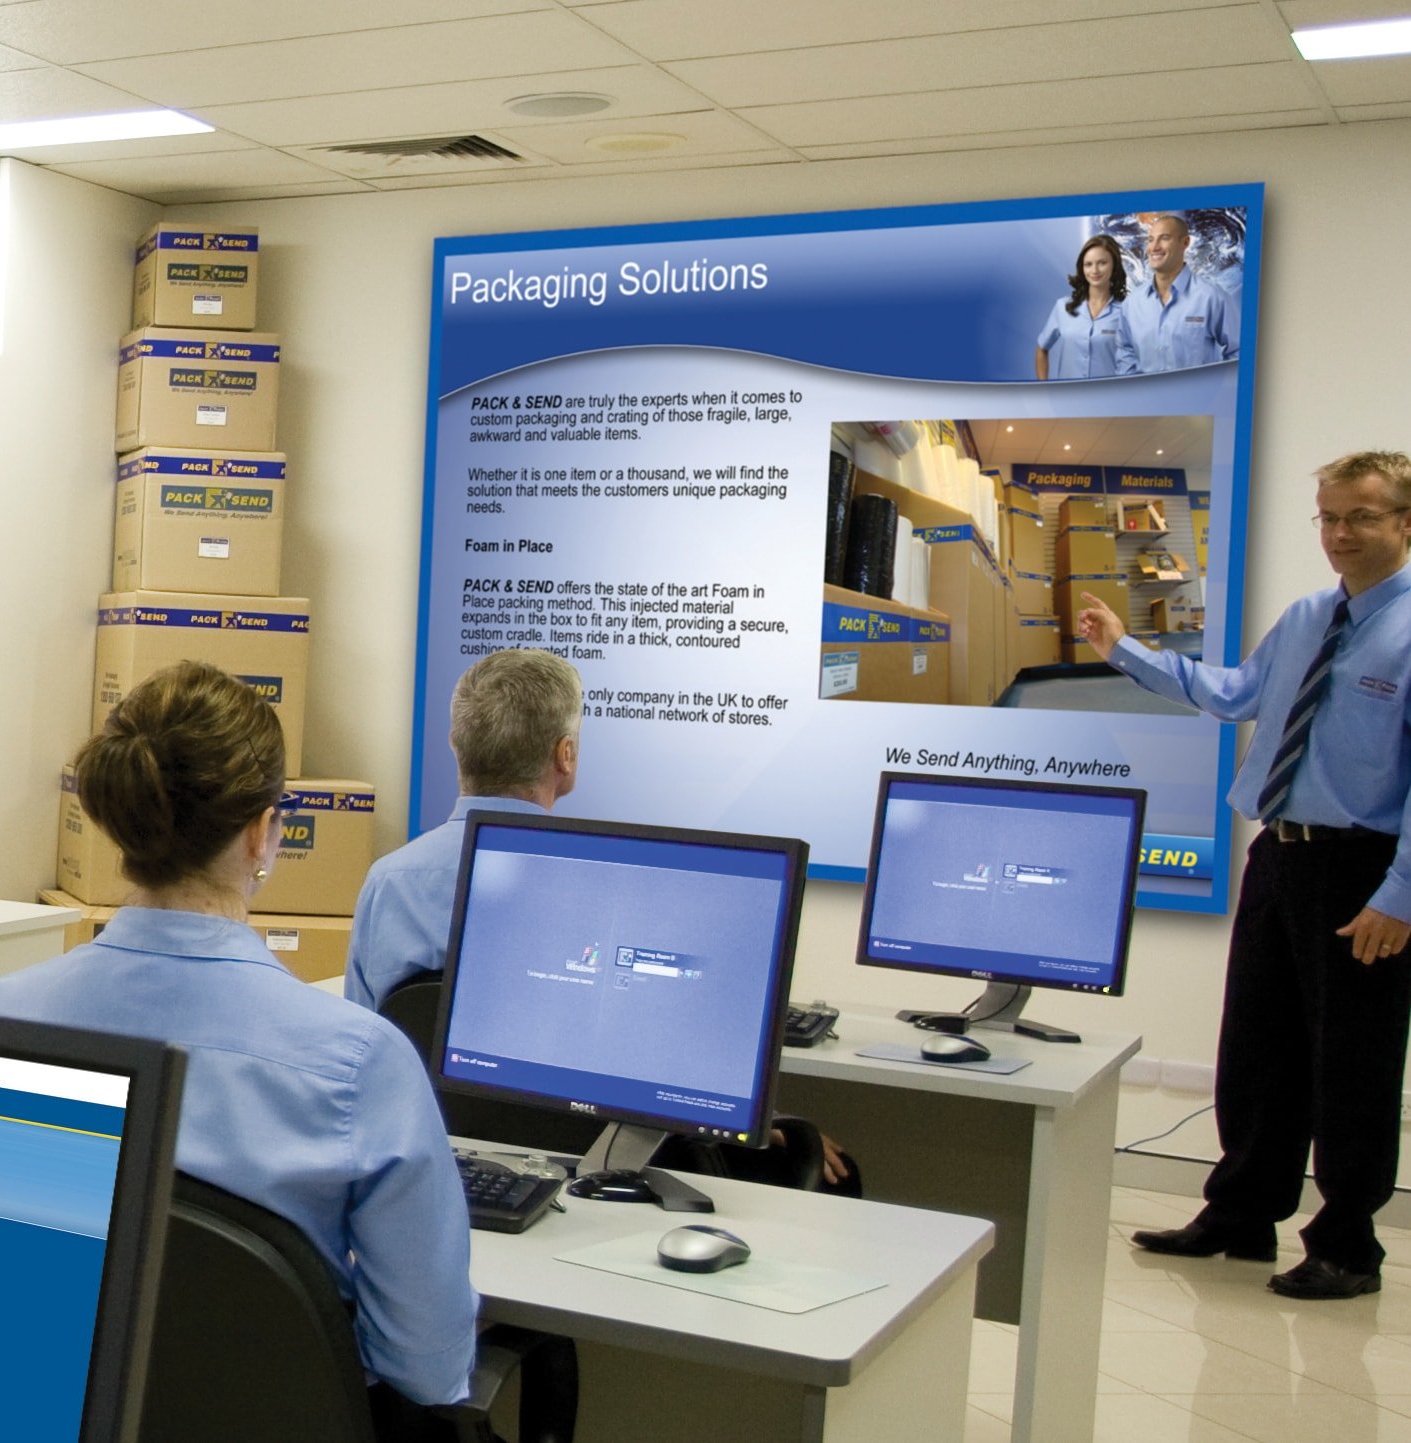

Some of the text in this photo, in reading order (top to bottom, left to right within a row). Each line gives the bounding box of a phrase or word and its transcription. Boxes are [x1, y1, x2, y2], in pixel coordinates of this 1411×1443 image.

[174, 238, 249, 248] PACK SEND
[170, 269, 245, 278] PACK SEND
[451, 258, 768, 308] Packaging Solutions
[175, 346, 251, 357] PACK SEND
[173, 374, 254, 386] PACK SEND
[471, 389, 802, 410] PACK & SEND are truly the experts when it comes to
[470, 406, 791, 428] custom packaging and crating of those fragile, large,
[469, 426, 641, 442] awkward and valuable items.
[181, 463, 258, 474] PACK SEND
[468, 465, 789, 482] Whether it is one item or a thousand, we will find the
[1027, 472, 1174, 488] Packaging Materials
[467, 482, 787, 500] solution that meets the customers unique packaging
[165, 492, 269, 507] PACK SEND
[466, 500, 505, 514] needs.
[465, 538, 553, 553] Foam in Place
[463, 578, 765, 599] PACK & SEND offers the state of the art Foam in
[462, 593, 734, 615] Place packing method. This injected material
[139, 613, 268, 627] SEND PACK SEND
[461, 611, 788, 634] expands in the box to fit any item, providing a secure,
[838, 616, 900, 634] PACK SEND
[588, 687, 788, 710] only company in the UK to offer
[886, 747, 1131, 778] We Send Anything, Anywhere
[302, 796, 330, 806] PACK
[1139, 848, 1198, 868] SEND
[570, 1101, 596, 1114] DELL
